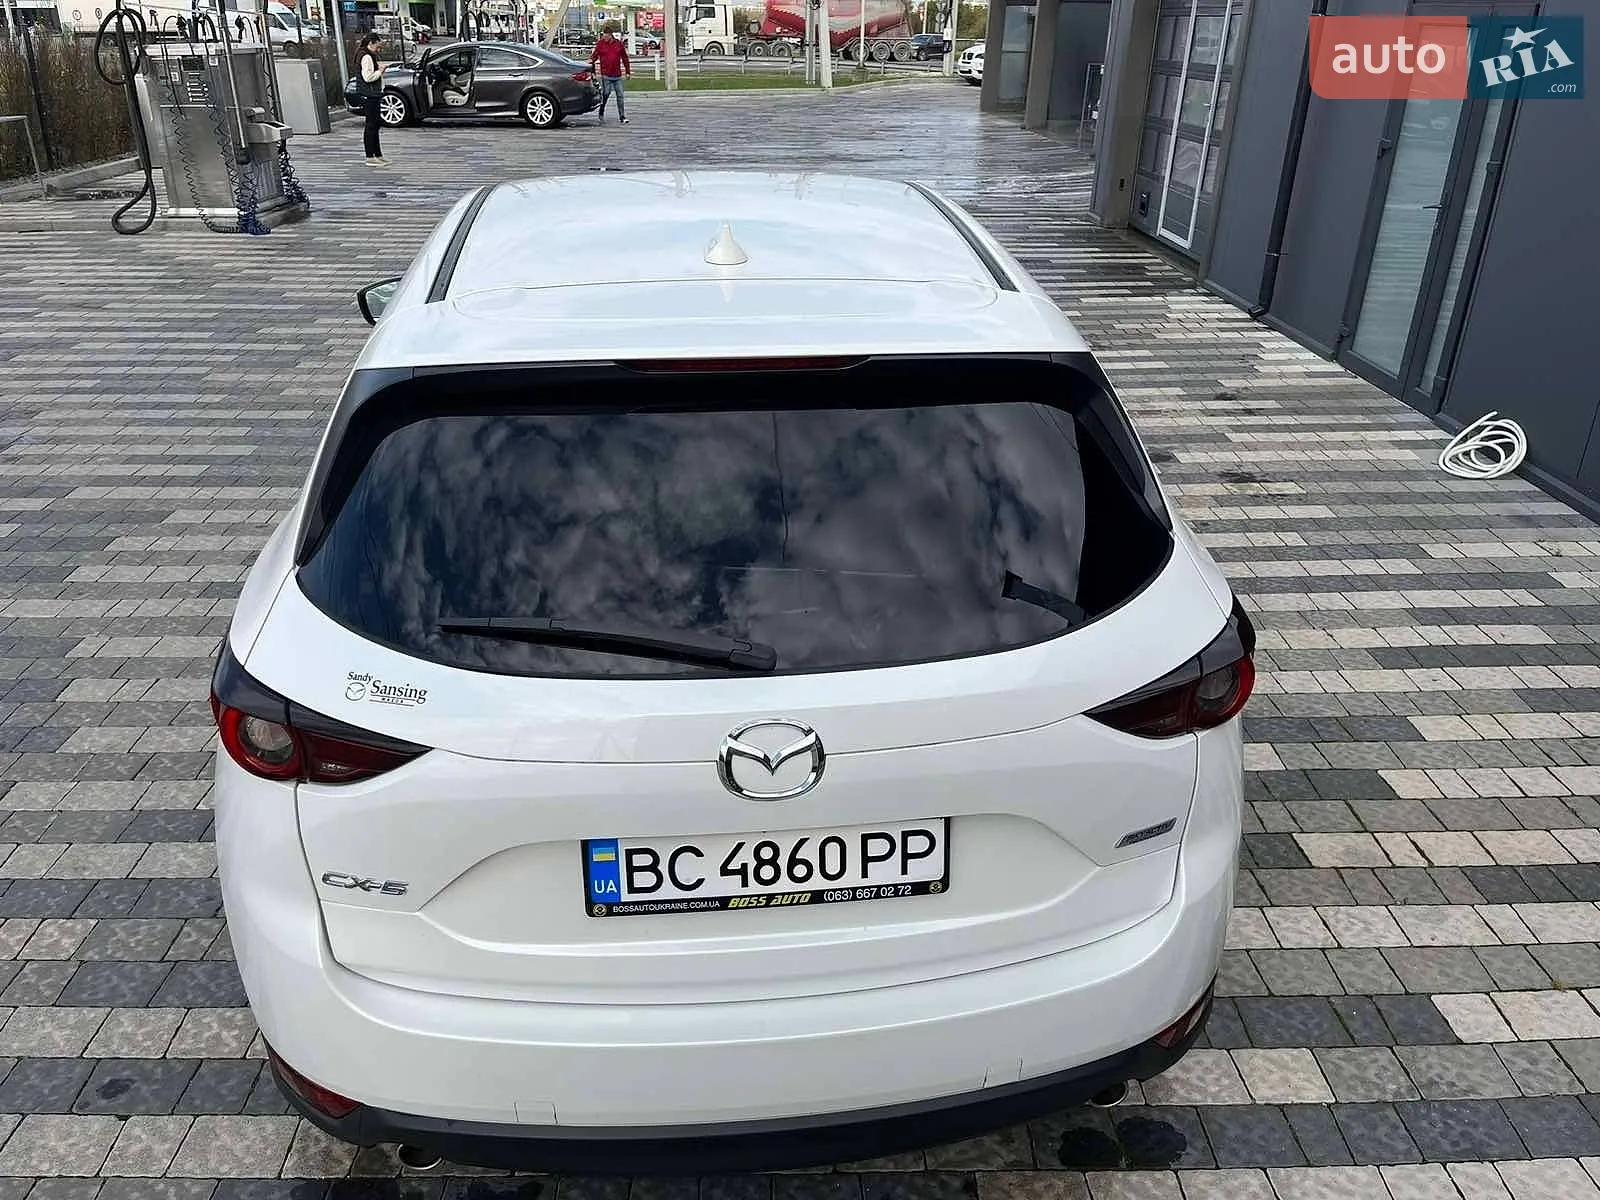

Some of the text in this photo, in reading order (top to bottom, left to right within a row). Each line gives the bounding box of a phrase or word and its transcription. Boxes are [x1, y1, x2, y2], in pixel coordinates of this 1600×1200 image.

[347, 671, 373, 685] Sandy
[370, 679, 427, 704] Sansing
[624, 828, 936, 895] BC 4860 PP
[322, 871, 408, 896] CX-5
[594, 880, 618, 894] UA
[823, 885, 912, 902] (063) 667 02 72
[612, 900, 721, 913] BOSSAUTOUKRAINE.COM.UA
[728, 895, 767, 908] BOSS
